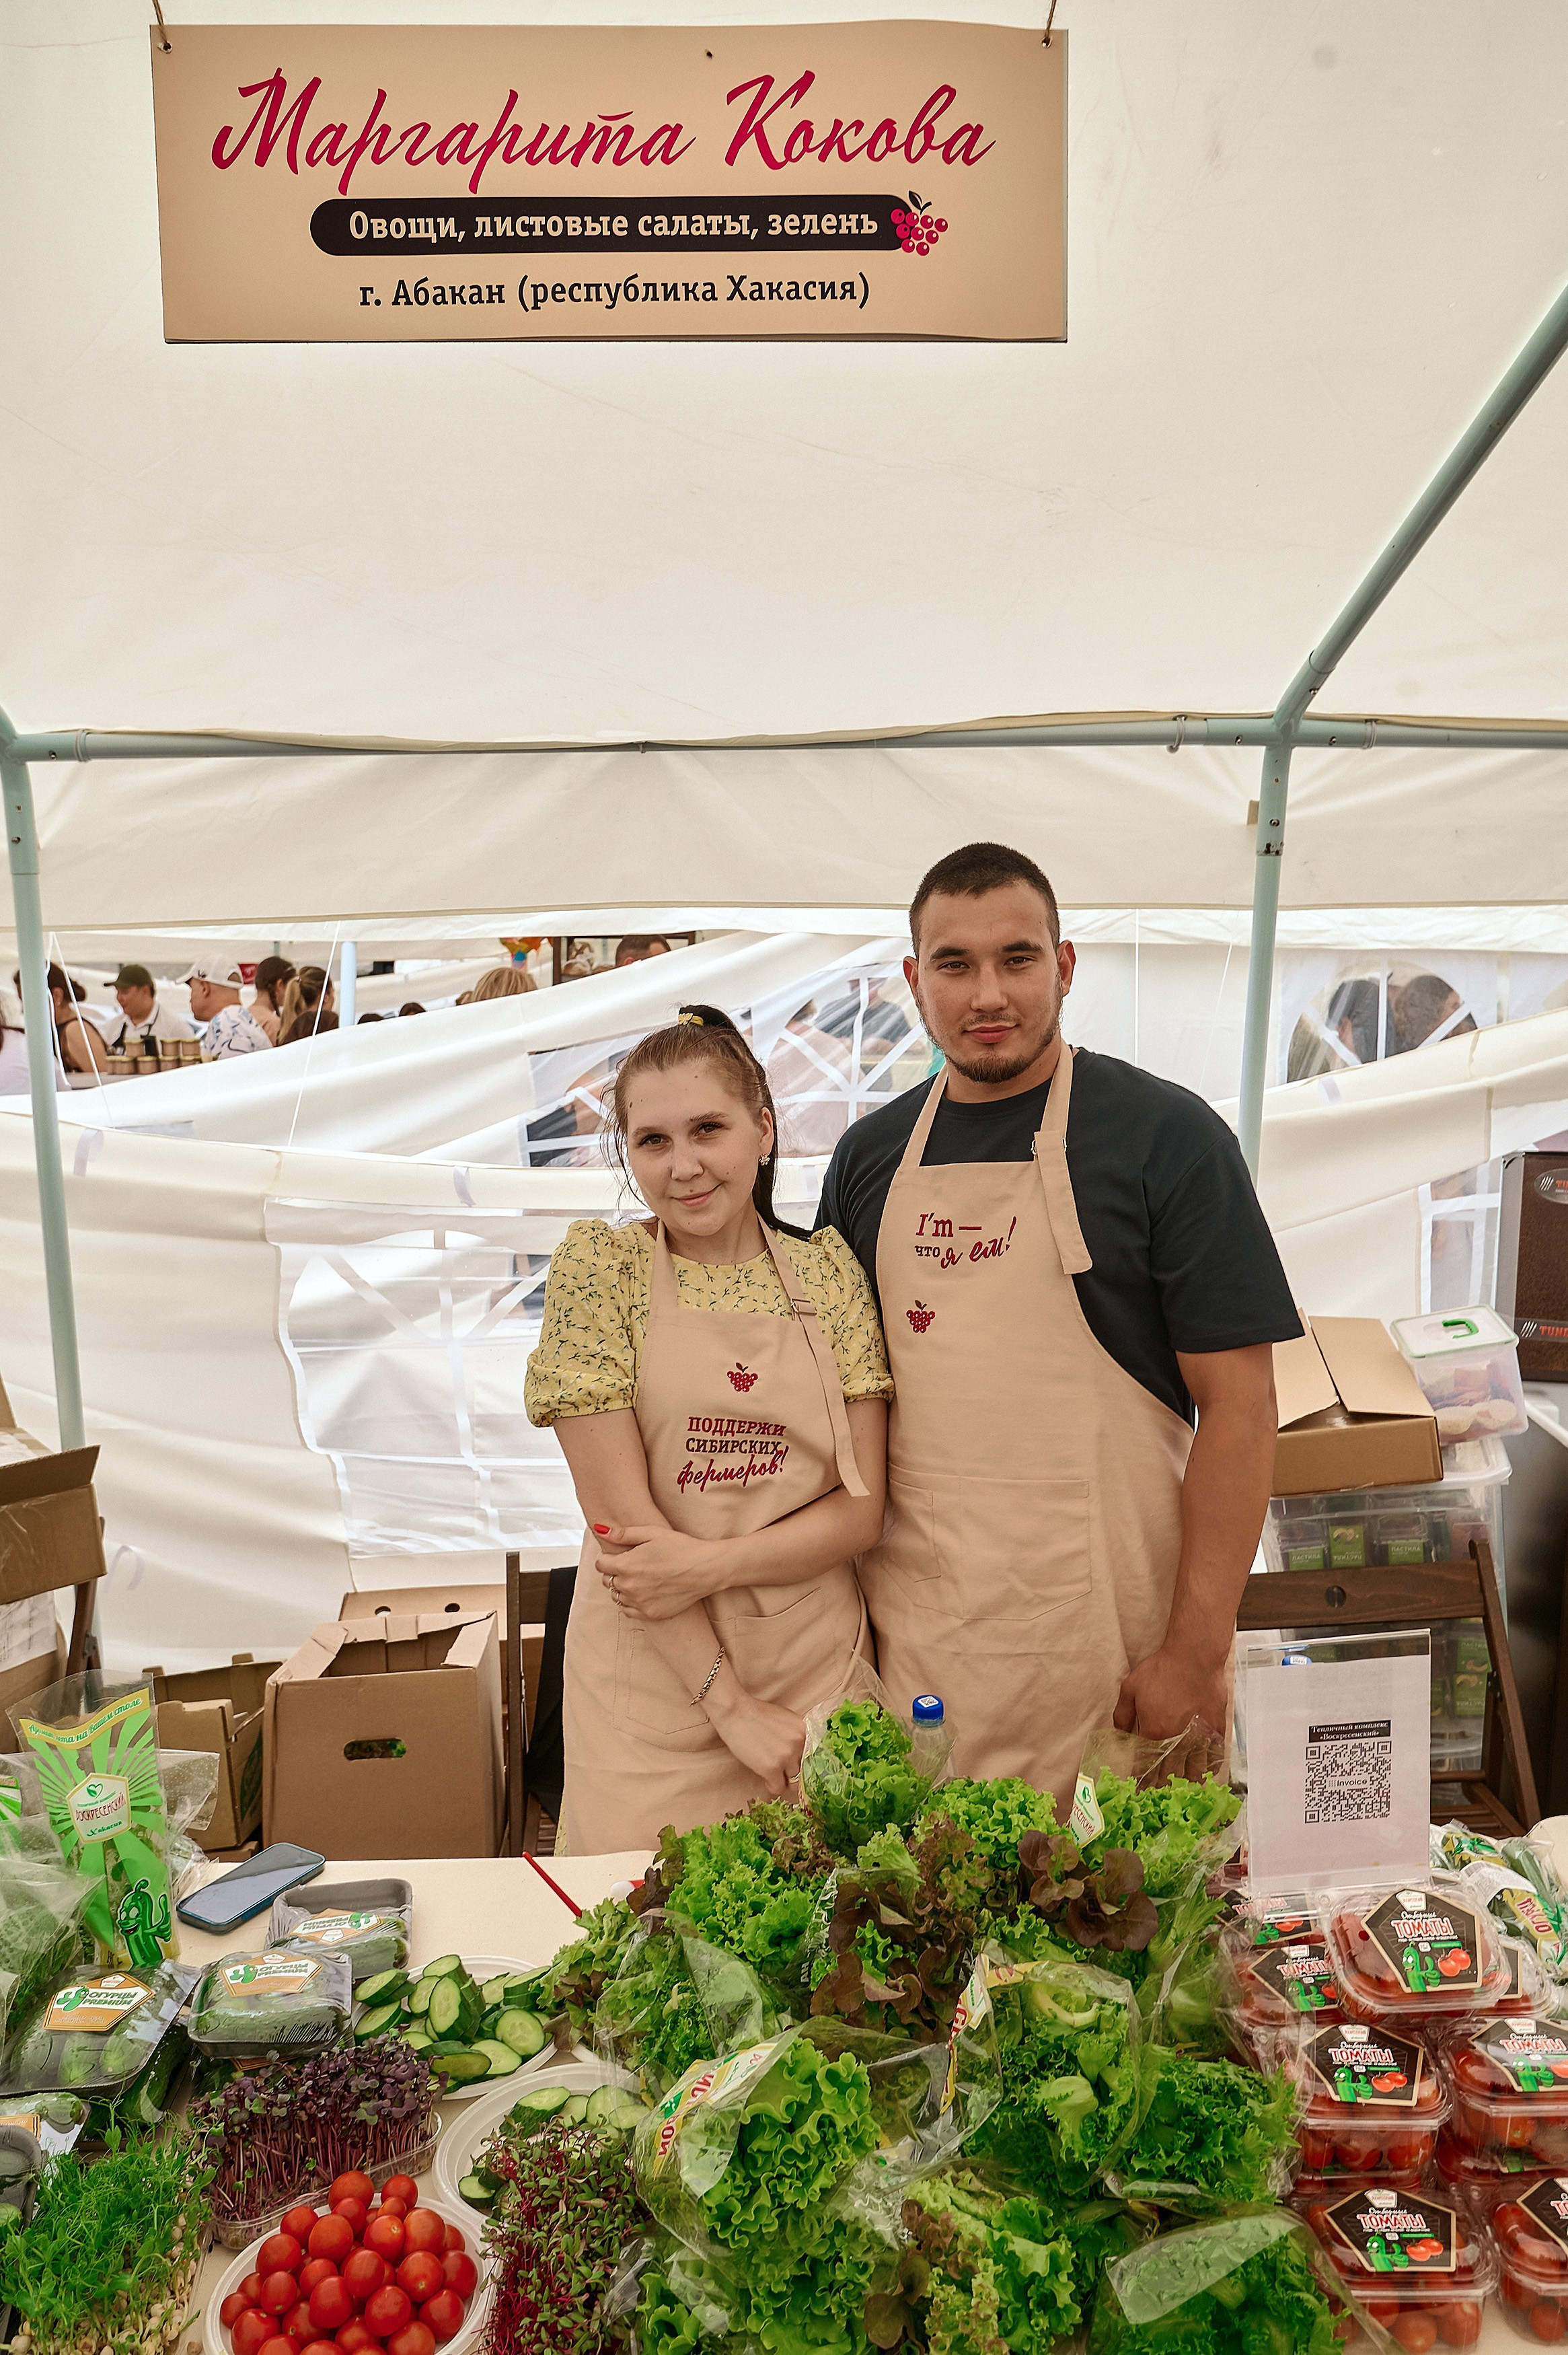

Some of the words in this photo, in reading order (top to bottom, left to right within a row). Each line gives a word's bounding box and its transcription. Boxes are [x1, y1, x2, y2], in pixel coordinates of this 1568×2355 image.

[211, 67, 696, 196] Маргарита
[724, 70, 996, 170] Кокова
[349, 211, 465, 244] Овощи,
[474, 215, 629, 238] листовые
[638, 213, 759, 240] салаты,
[768, 213, 879, 236] зелень
[359, 286, 382, 306] г.
[391, 276, 506, 306] Абакан
[518, 274, 718, 314] (республика
[726, 271, 870, 310] Хакасия)
[916, 1212, 954, 1237] I'm
[914, 1245, 940, 1258] что
[940, 1247, 963, 1269] я
[969, 1216, 1017, 1262] ем!
[687, 1416, 786, 1437] ПОДДЕРЖИ
[685, 1437, 782, 1455] СИБИРСКИХ
[677, 1445, 789, 1494] фермеров!
[114, 1698, 142, 1716] столе
[1311, 1723, 1353, 1733] Тепличный
[1354, 1721, 1389, 1730] комплекс
[1337, 1778, 1368, 1786] Invoice
[1391, 1917, 1455, 1939] ТОМАТЫ
[81, 1998, 133, 2006] PREMIUM
[89, 1991, 138, 2000] ОГУРЦЫ
[1499, 2037, 1567, 2053] ТОМАТЫ
[1328, 2048, 1394, 2064] ТОМАТЫ
[1356, 2213, 1427, 2229] ТОМАТЫ
